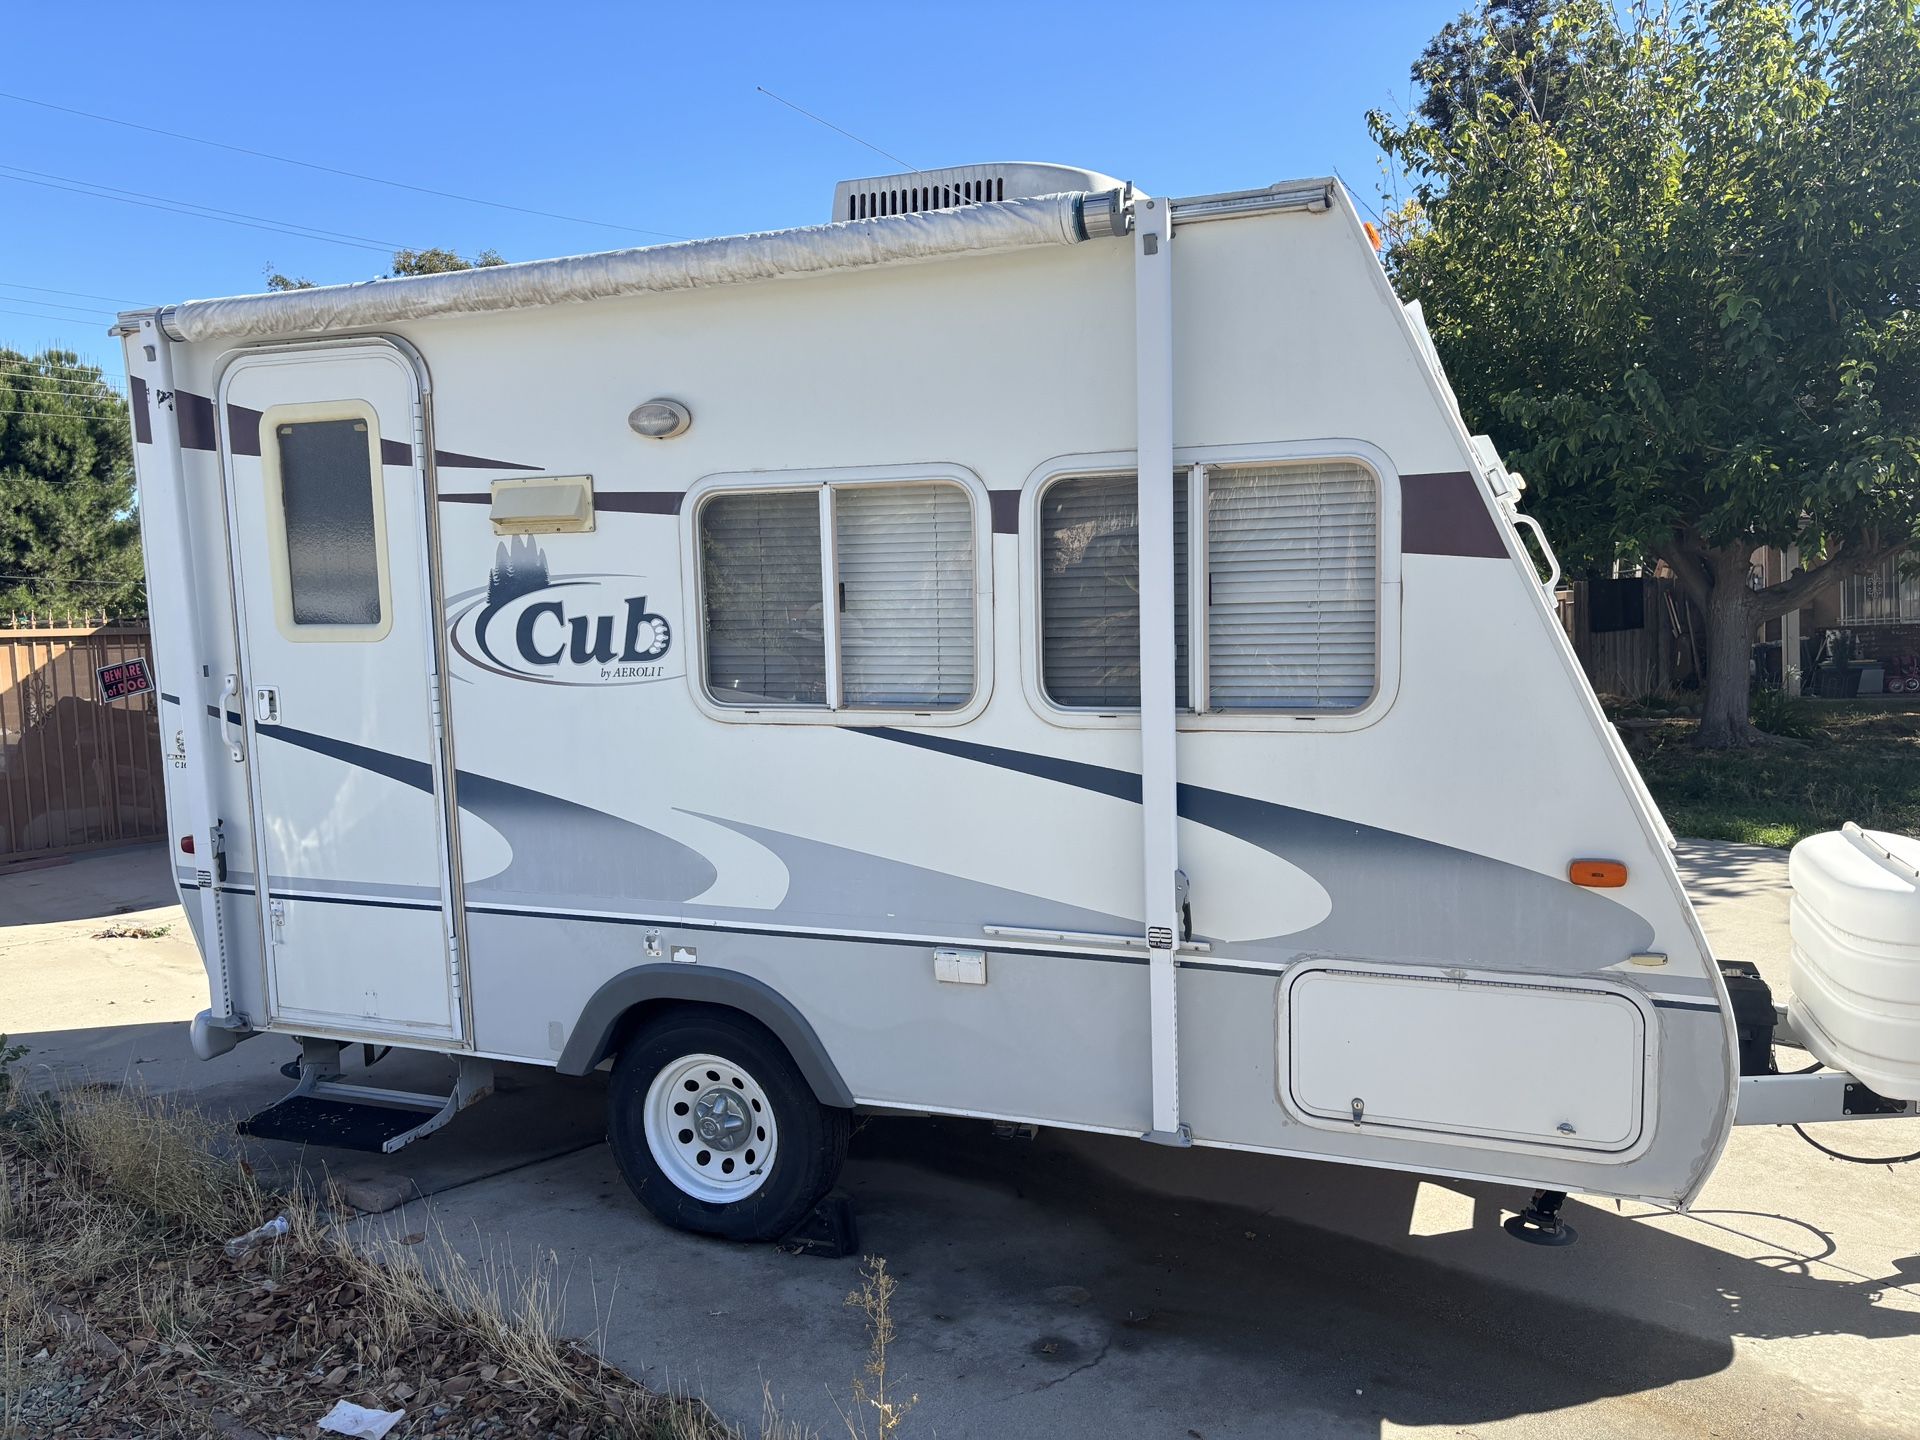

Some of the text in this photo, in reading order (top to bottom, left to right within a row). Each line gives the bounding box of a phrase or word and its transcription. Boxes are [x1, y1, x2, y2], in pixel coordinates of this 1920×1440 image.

[516, 595, 672, 665] Cub
[601, 668, 611, 680] by
[108, 678, 146, 696] of DOG
